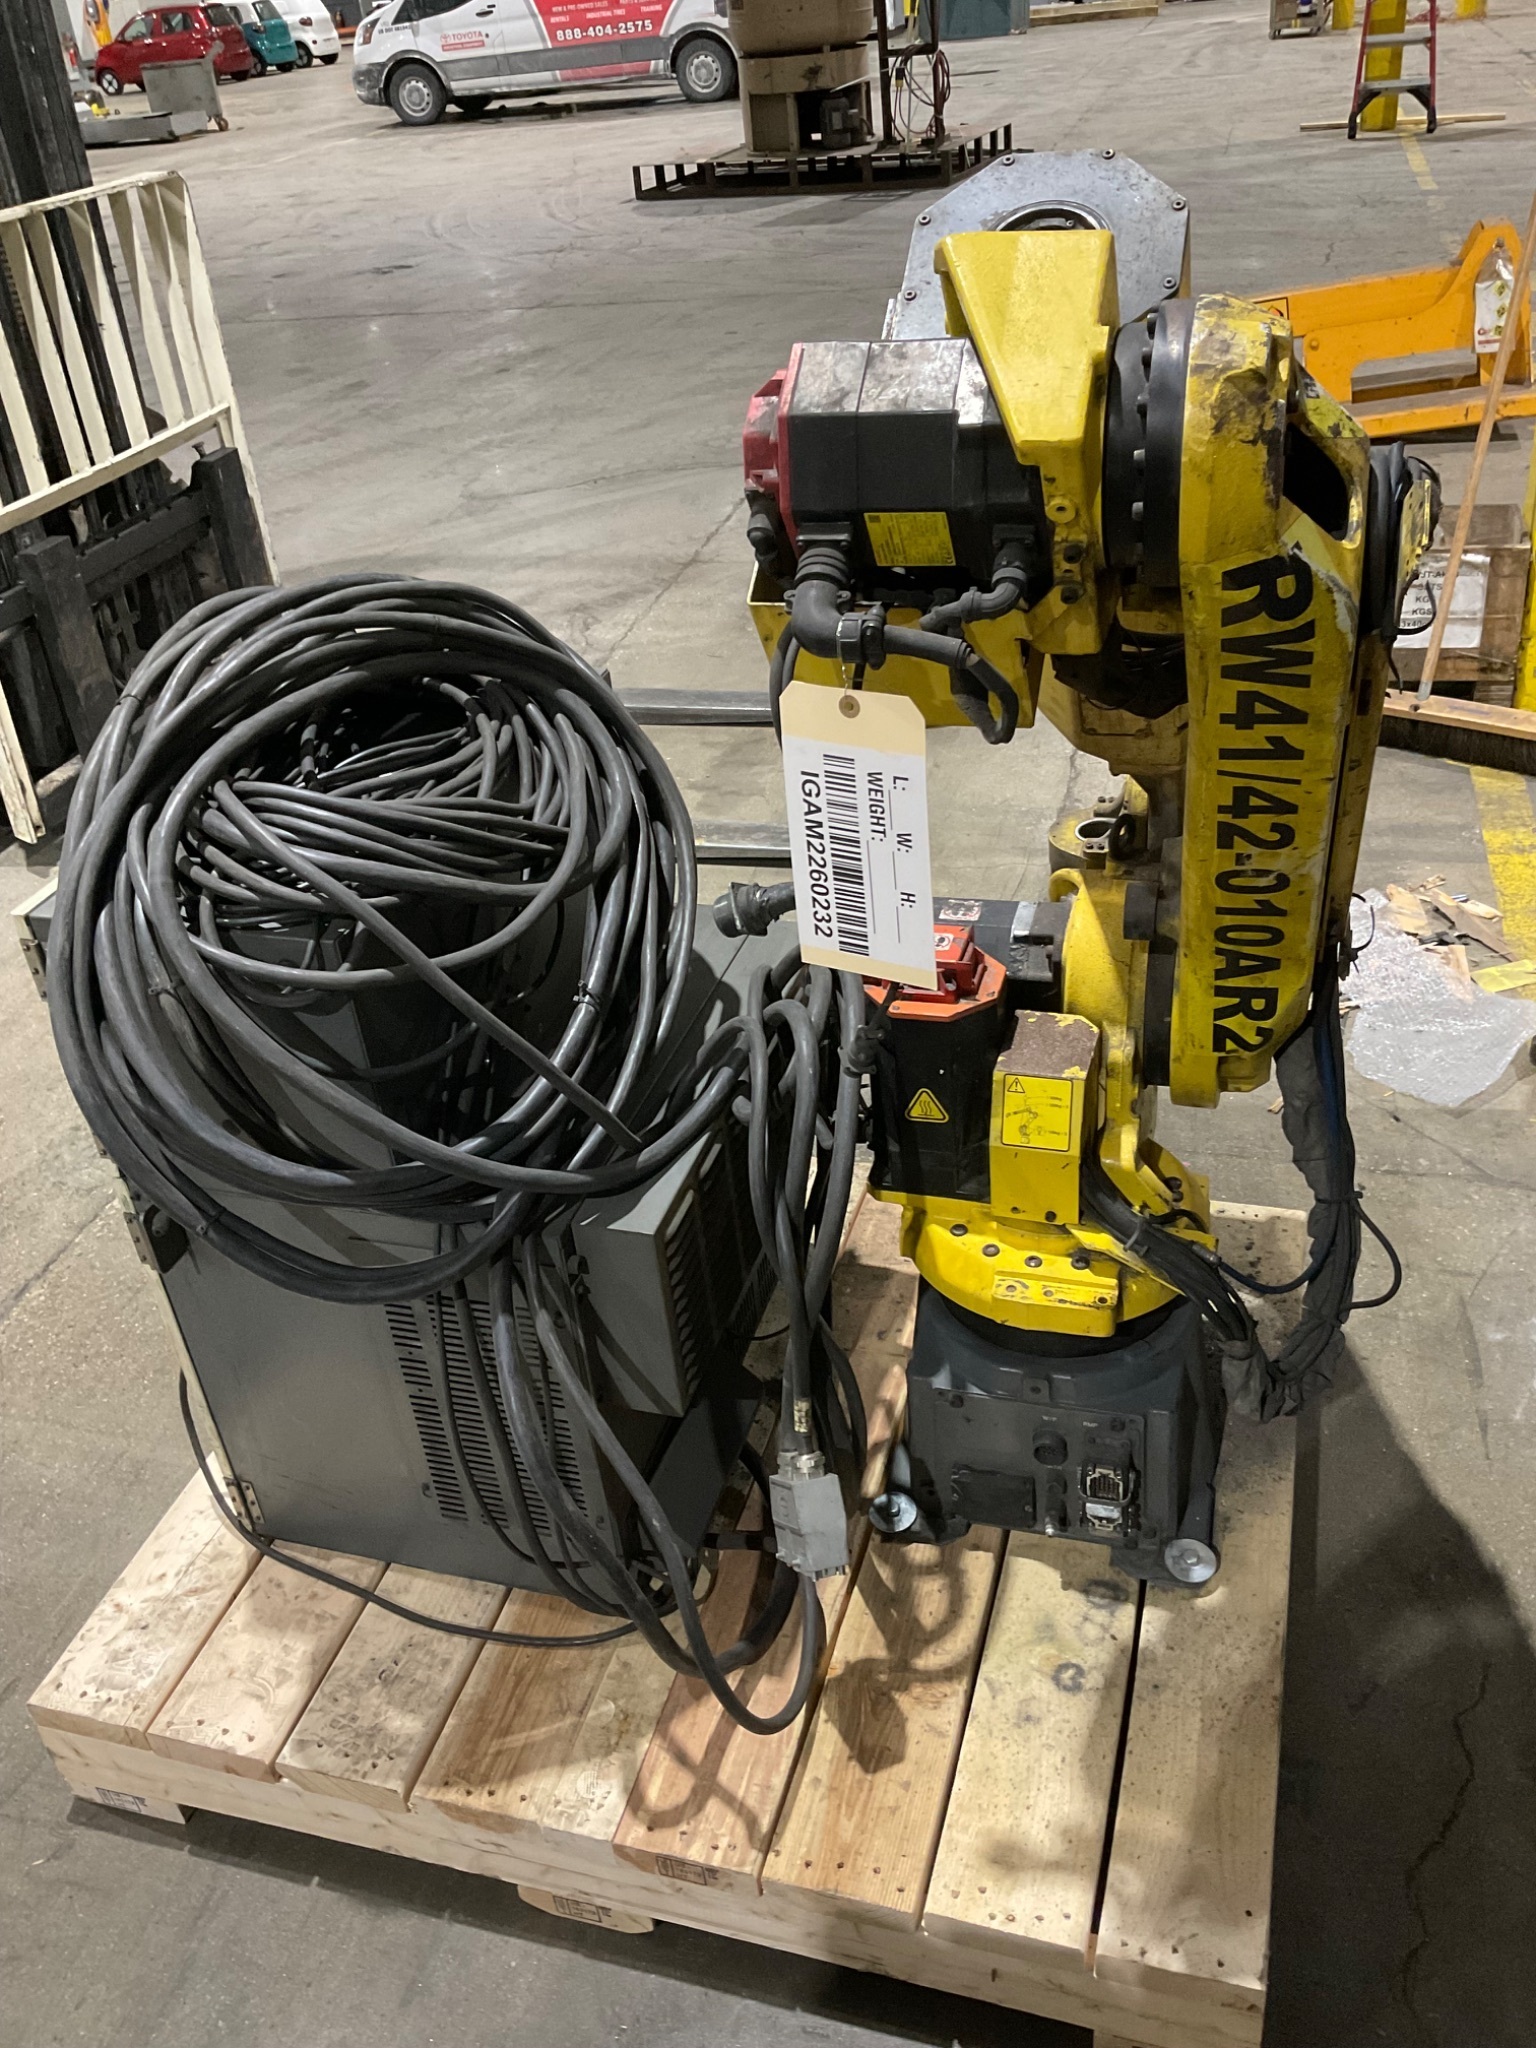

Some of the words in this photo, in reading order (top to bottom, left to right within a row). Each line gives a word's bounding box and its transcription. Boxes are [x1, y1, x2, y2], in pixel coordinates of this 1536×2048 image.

[640, 4, 663, 12] TRAINING
[452, 31, 483, 41] TOYOTA
[556, 20, 653, 41] 888-404-2575
[892, 775, 909, 791] L:
[866, 771, 886, 842] WEIGHT:
[1212, 545, 1315, 1053] RW41/42-010AR2
[896, 832, 913, 853] W:
[800, 770, 833, 938] IGAM2260232
[900, 891, 916, 909] H:
